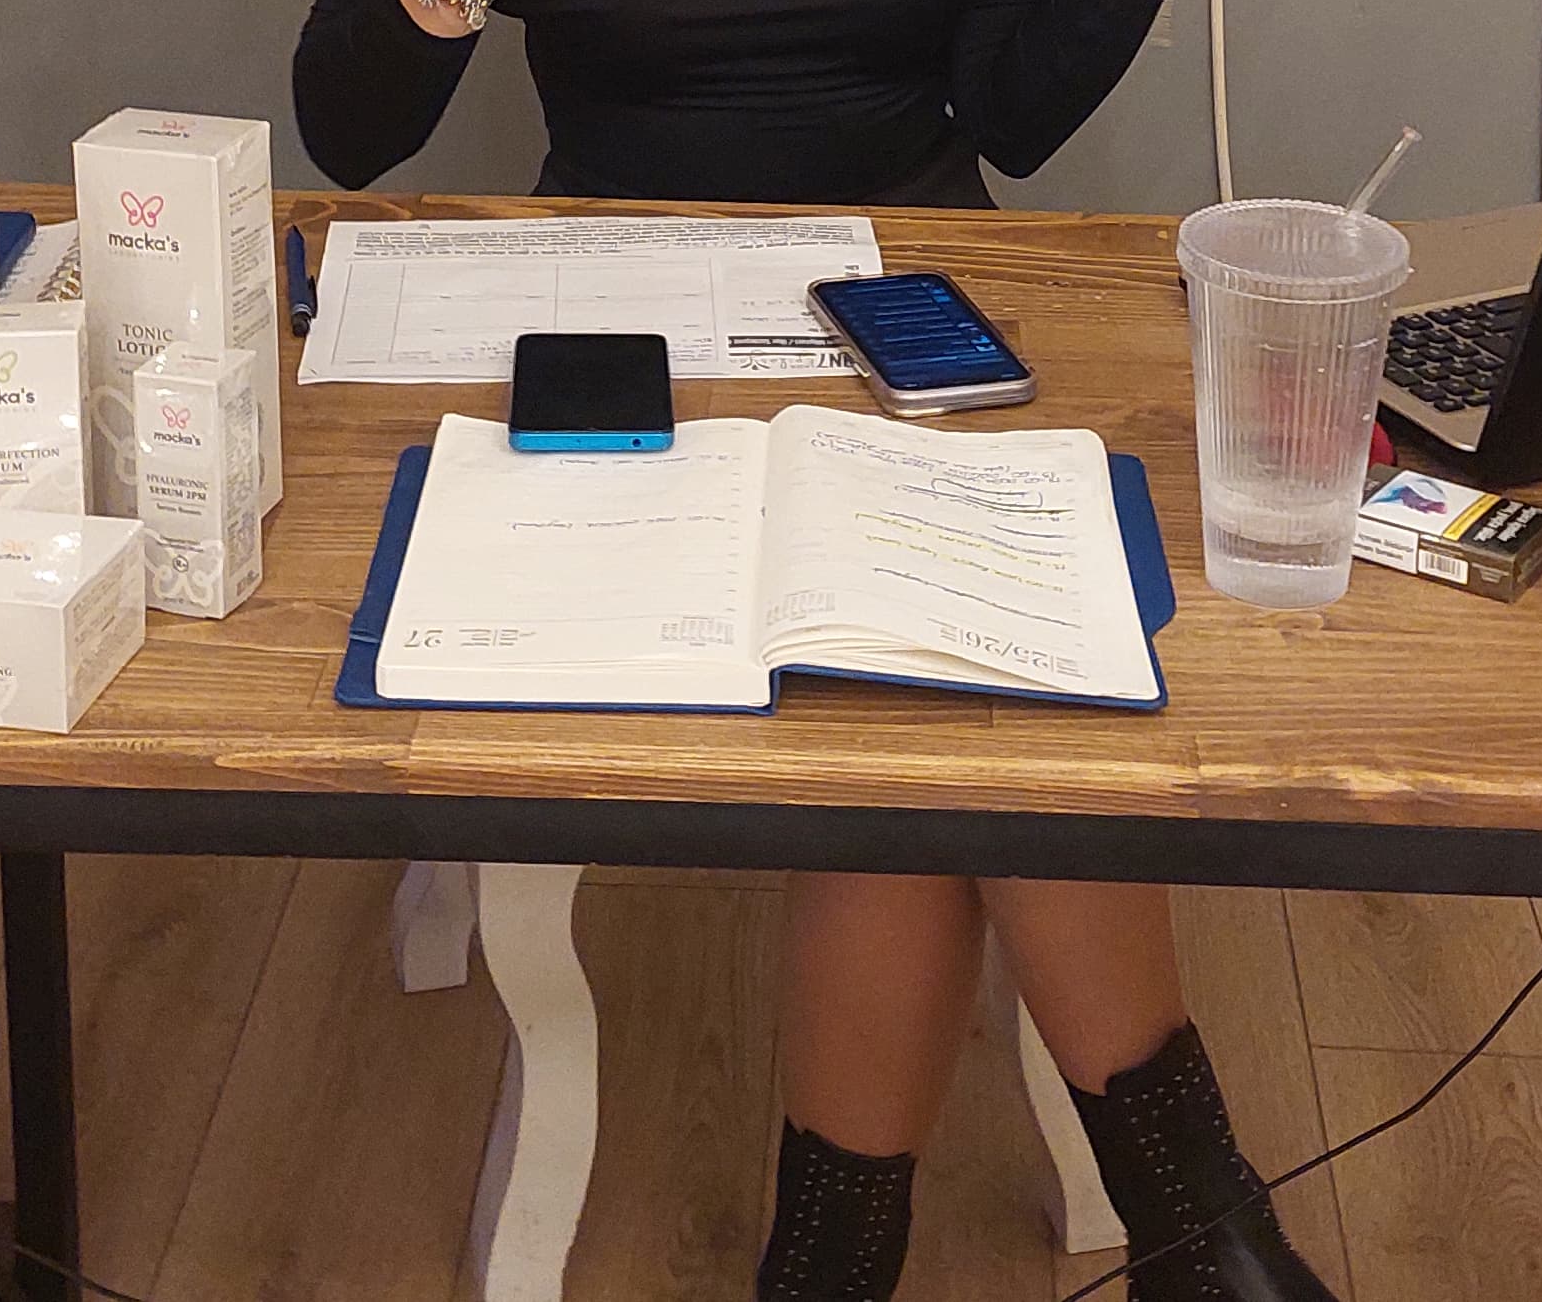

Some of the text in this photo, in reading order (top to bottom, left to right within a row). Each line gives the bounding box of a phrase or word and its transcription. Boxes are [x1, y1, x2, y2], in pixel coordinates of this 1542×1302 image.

[108, 231, 180, 254] macka's
[122, 323, 173, 342] TONIC
[153, 430, 202, 447] macka's
[146, 473, 209, 491] HYALURONIC
[403, 628, 444, 649] 27
[965, 628, 1050, 671] 25/26
